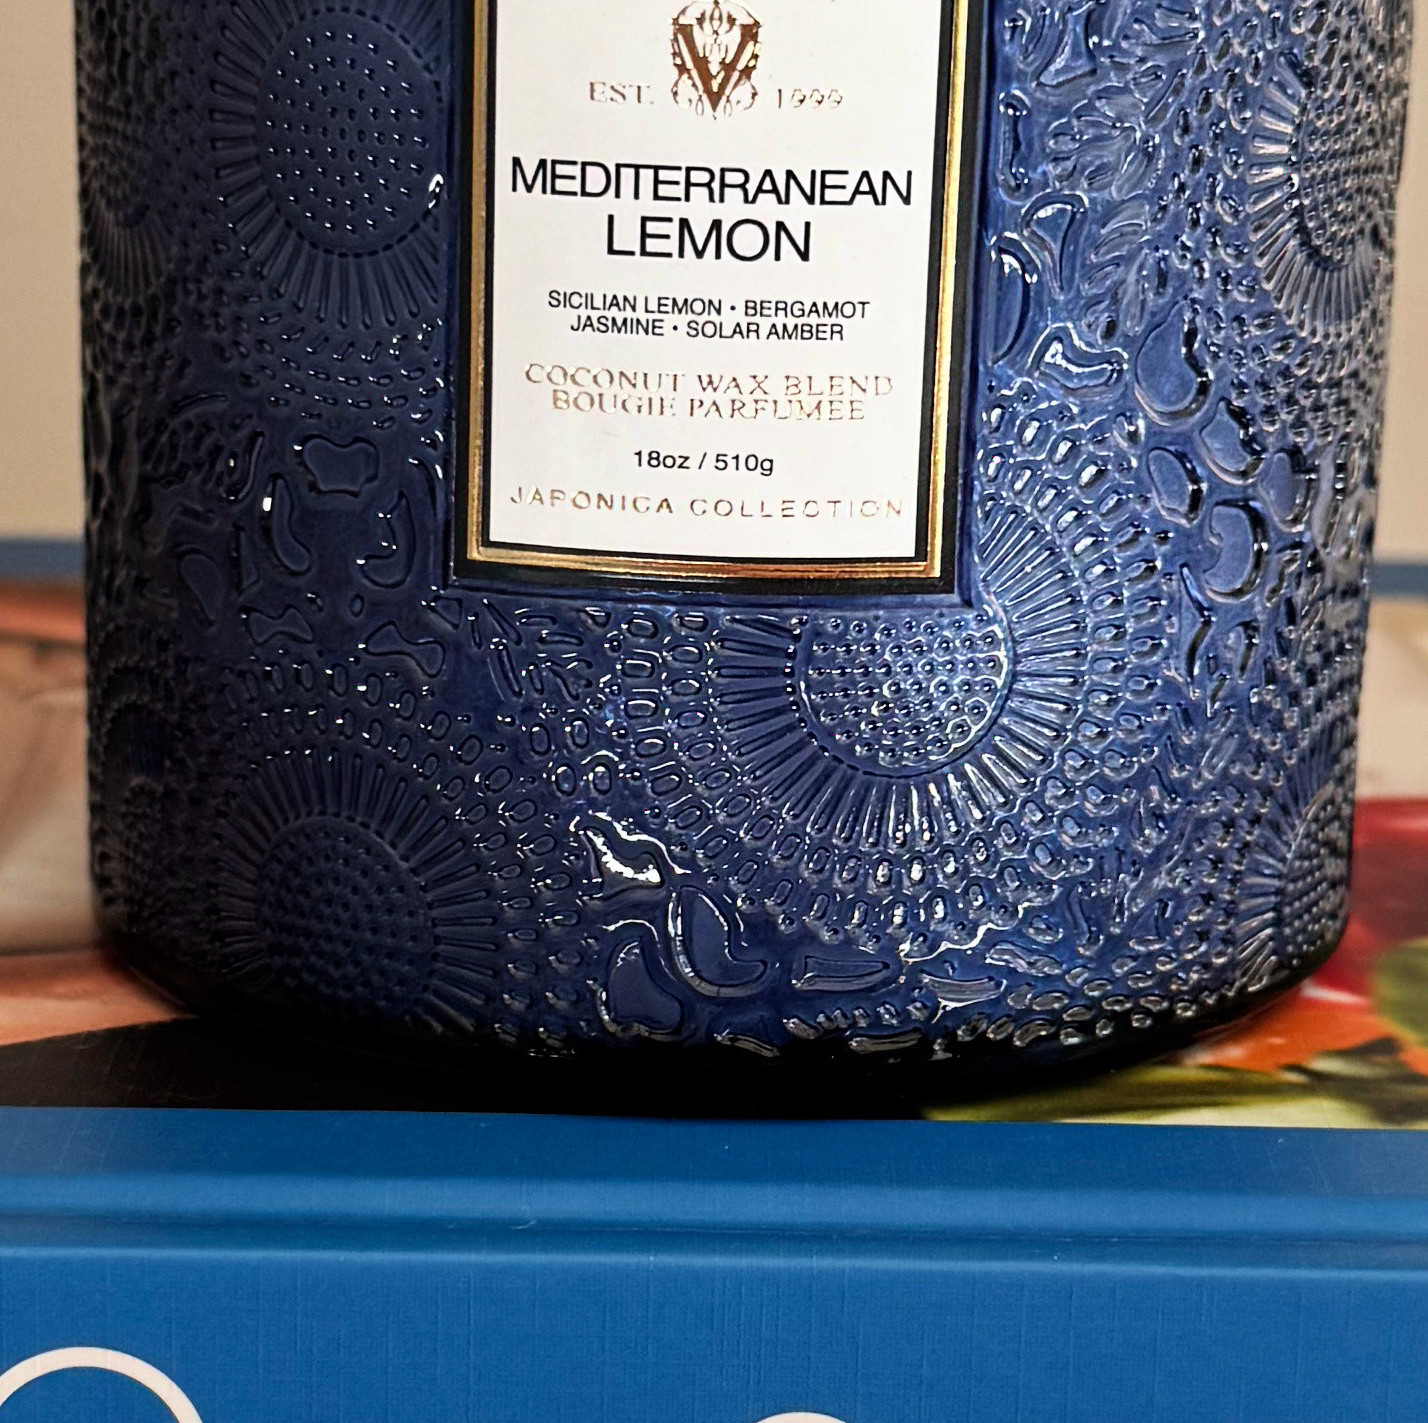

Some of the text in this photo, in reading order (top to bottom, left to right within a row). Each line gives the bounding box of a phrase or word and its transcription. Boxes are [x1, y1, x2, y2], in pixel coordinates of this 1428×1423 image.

[589, 80, 656, 106] EST.
[510, 155, 913, 207] MEDITERRANEAN
[606, 213, 812, 263] LEMON
[547, 289, 871, 320] SICILIAN LEMON BERGAMOT
[570, 315, 844, 342] JASMINE SOLAR AMBER
[524, 362, 895, 397] COCONUT WAX BLEND
[552, 389, 866, 421] BOUGIE PARFUMEE
[633, 449, 774, 478] 18oz / 510g
[509, 484, 904, 519] JAPONICA COLLECTION
